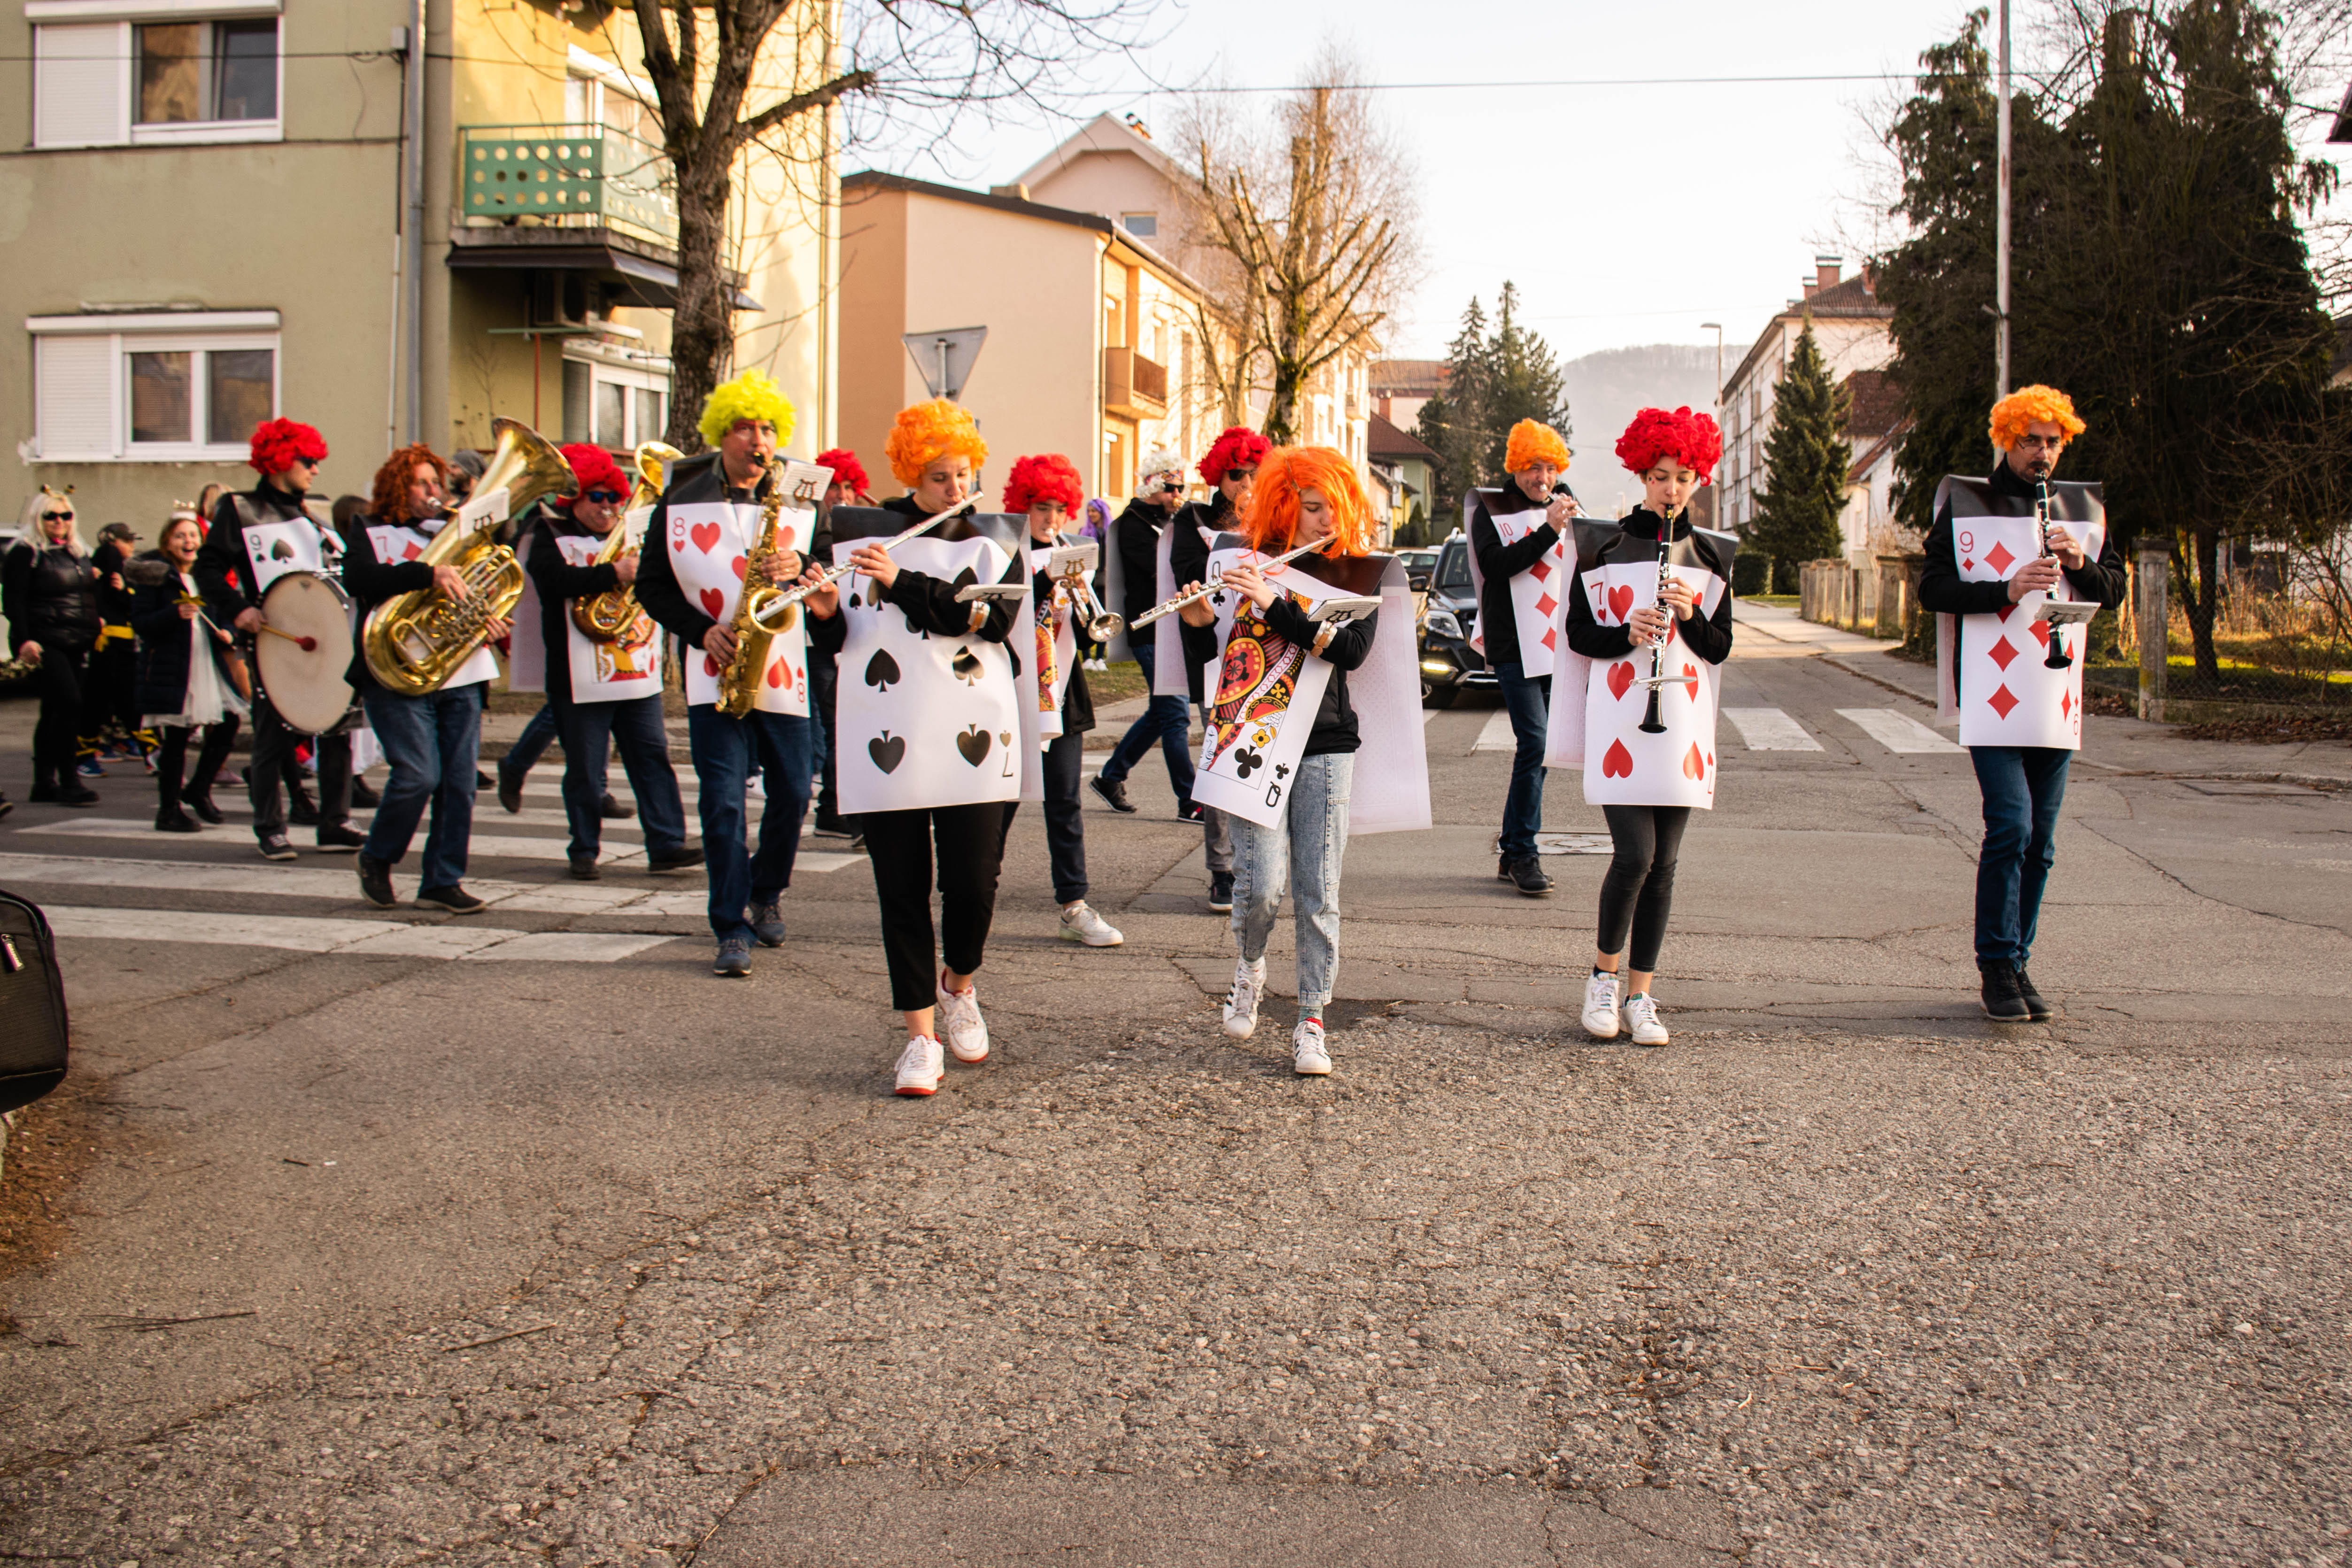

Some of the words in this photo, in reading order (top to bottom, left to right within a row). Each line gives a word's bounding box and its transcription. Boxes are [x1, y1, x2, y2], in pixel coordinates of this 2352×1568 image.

[673, 517, 685, 536] 8
[1499, 523, 1514, 537] 10
[250, 534, 262, 550] 9
[376, 536, 387, 553] 7
[1960, 531, 1973, 553] 9
[1590, 581, 1603, 605] 7
[797, 682, 805, 703] 8
[1002, 751, 1014, 778] 7
[1266, 781, 1281, 807] Q
